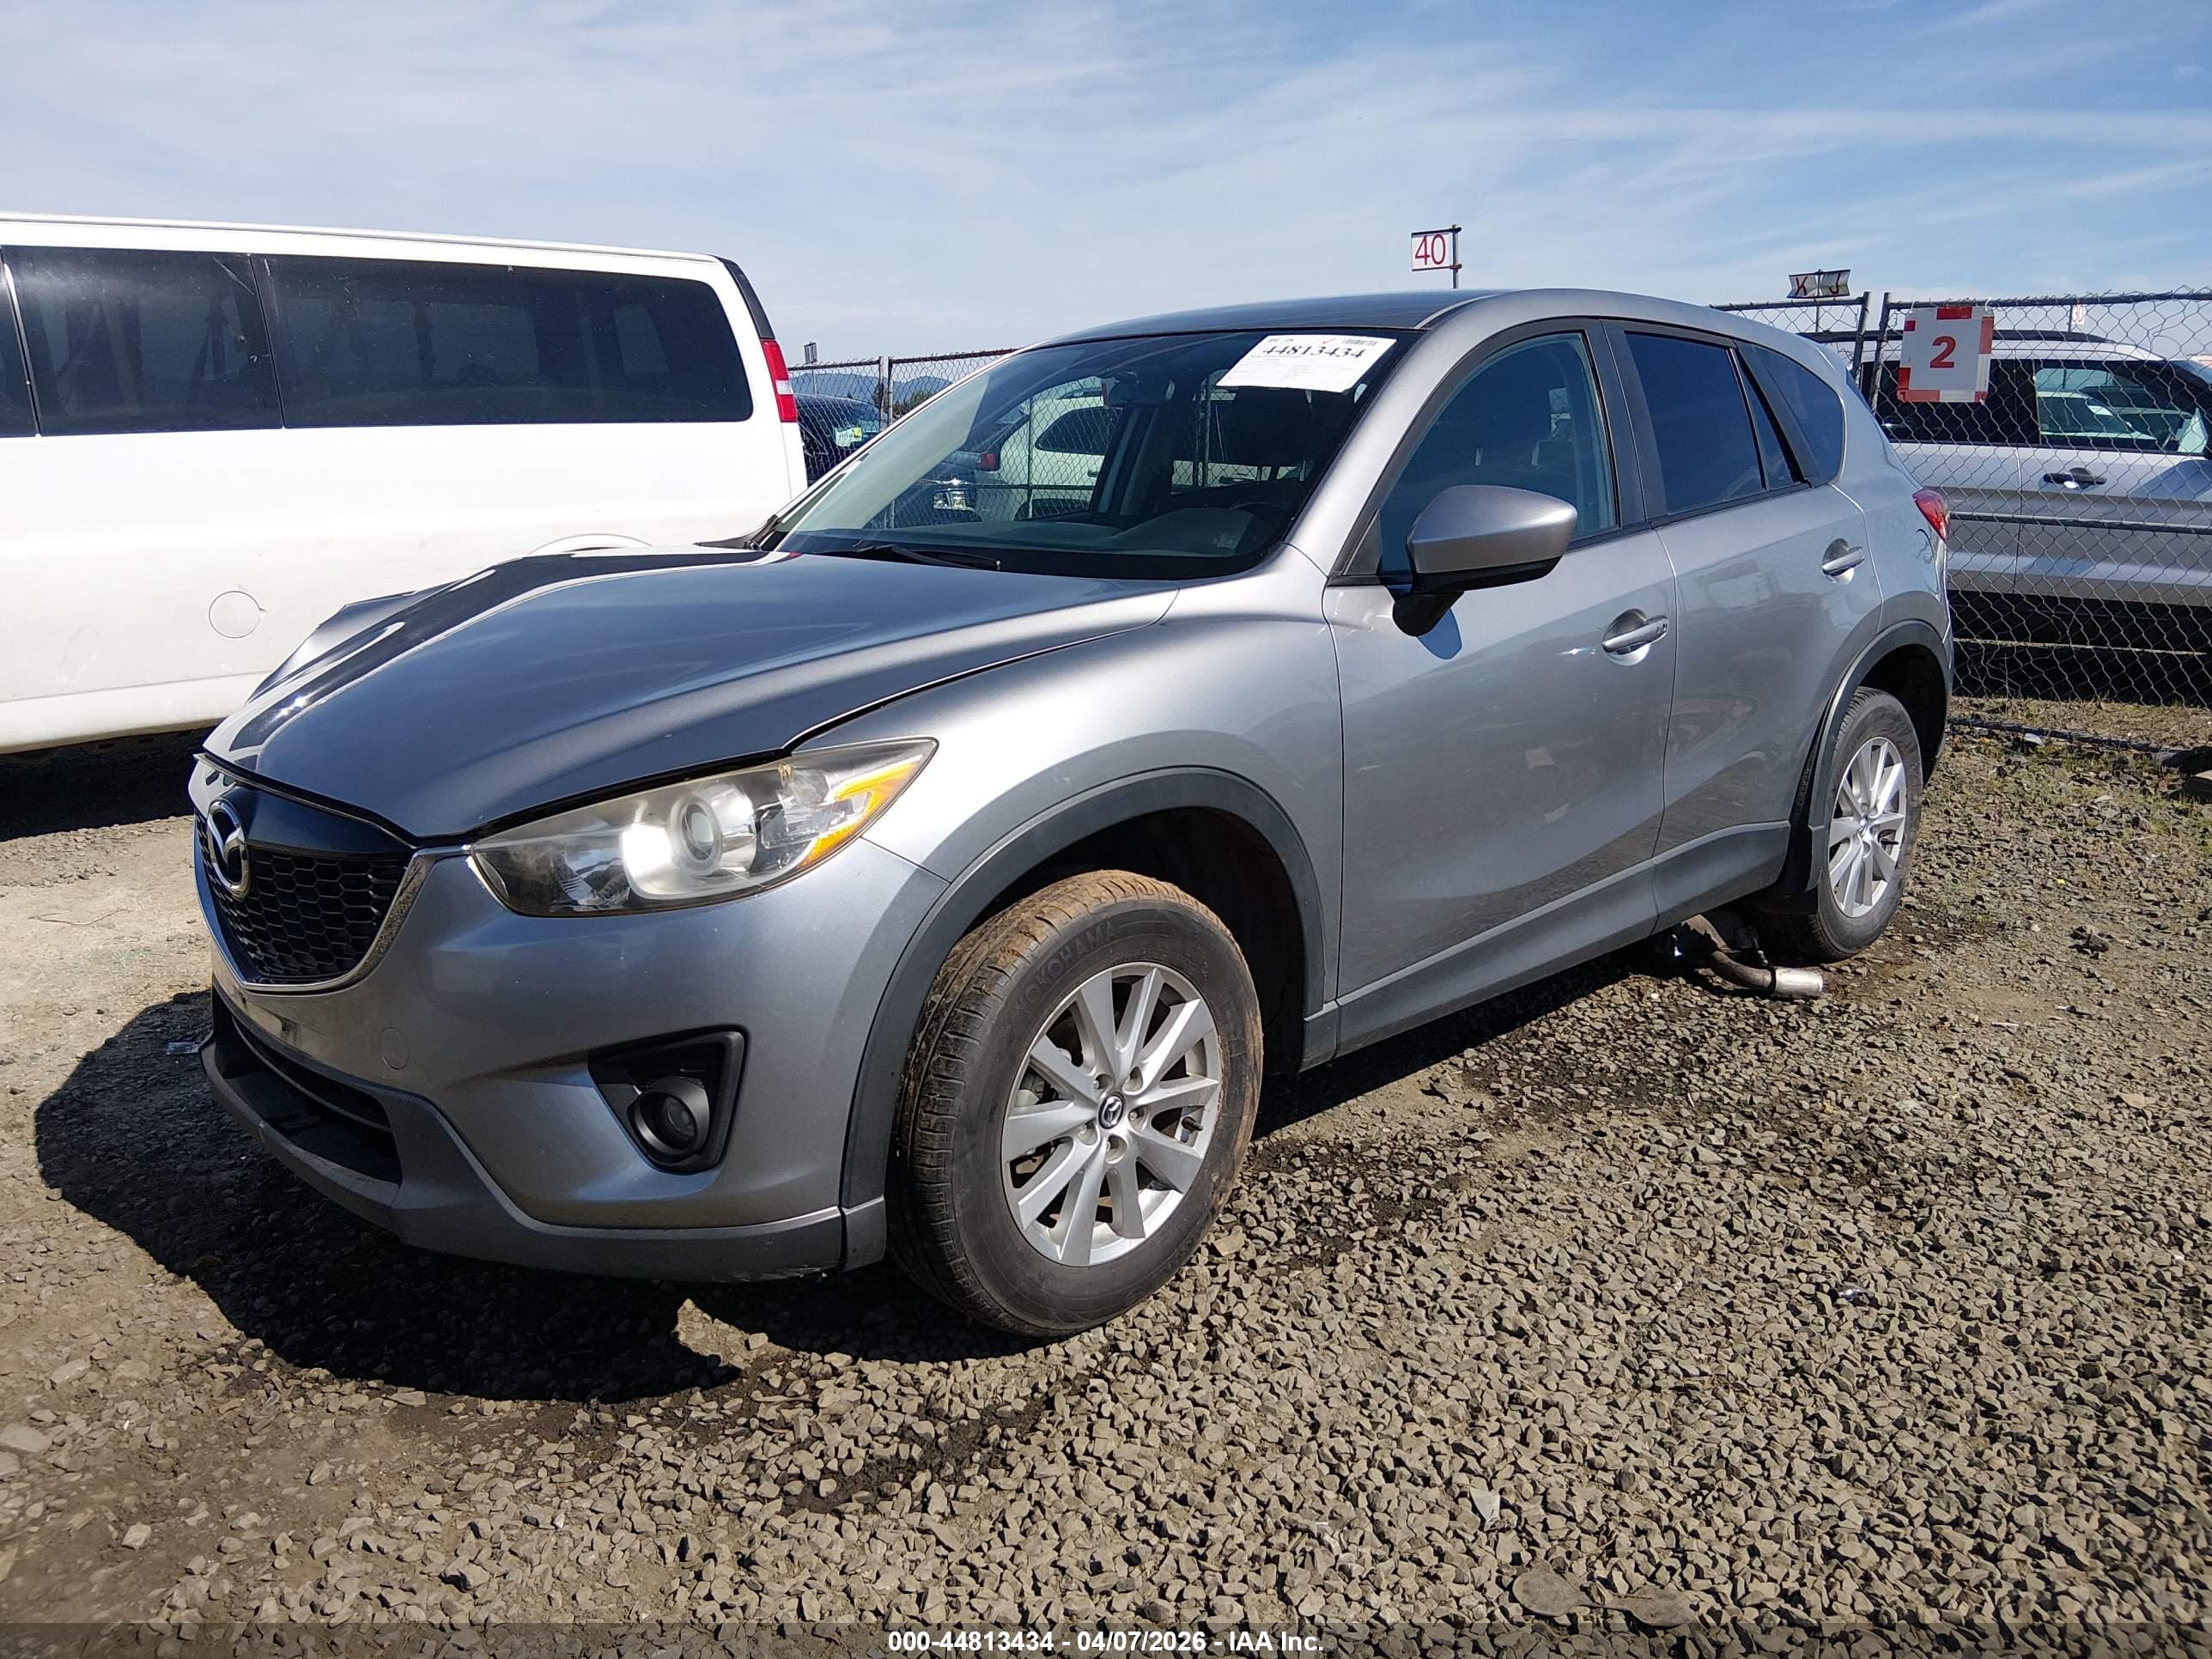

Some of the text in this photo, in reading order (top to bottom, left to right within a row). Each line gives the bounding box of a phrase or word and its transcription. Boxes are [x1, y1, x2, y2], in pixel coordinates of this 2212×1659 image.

[1414, 234, 1446, 265] 40
[1828, 272, 1842, 295] J
[1262, 345, 1366, 358] 44813434
[1929, 335, 1956, 368] 2
[1012, 921, 1117, 1012] YOKOHAMA
